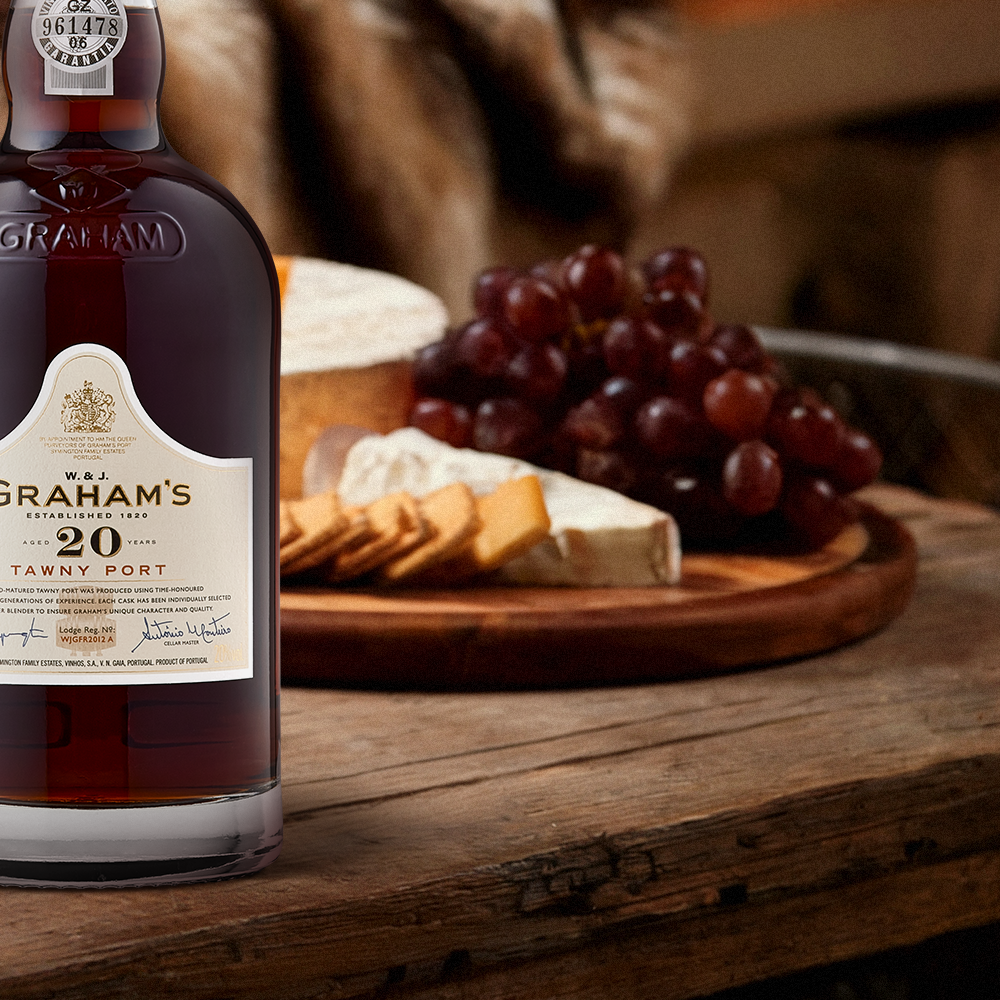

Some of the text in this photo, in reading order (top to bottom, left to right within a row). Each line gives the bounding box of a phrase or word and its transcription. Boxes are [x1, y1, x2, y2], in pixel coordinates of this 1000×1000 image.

[67, 0, 91, 12] GZ
[42, 17, 119, 36] 961478
[69, 36, 87, 49] 06
[44, 42, 115, 67] GARANTIA
[65, 471, 109, 480] W. & J.
[56, 525, 123, 558] 20
[10, 564, 166, 576] TAWNY PORT
[155, 585, 205, 593] TIME-HONOURED
[168, 595, 207, 603] INDIVIDUALLY
[59, 626, 82, 635] Lodge
[84, 626, 100, 635] Reg.
[60, 636, 106, 645] WJGFR2012
[22, 659, 40, 667] FAMILY
[41, 659, 64, 668] ESTATES,
[65, 659, 85, 668] VINHOS,
[100, 659, 105, 667] V.
[106, 659, 111, 667] N.
[112, 659, 126, 667] GAIA,
[155, 658, 178, 666] PRODUCT
[179, 657, 185, 665] OF
[186, 656, 208, 665] PORTUGAL
